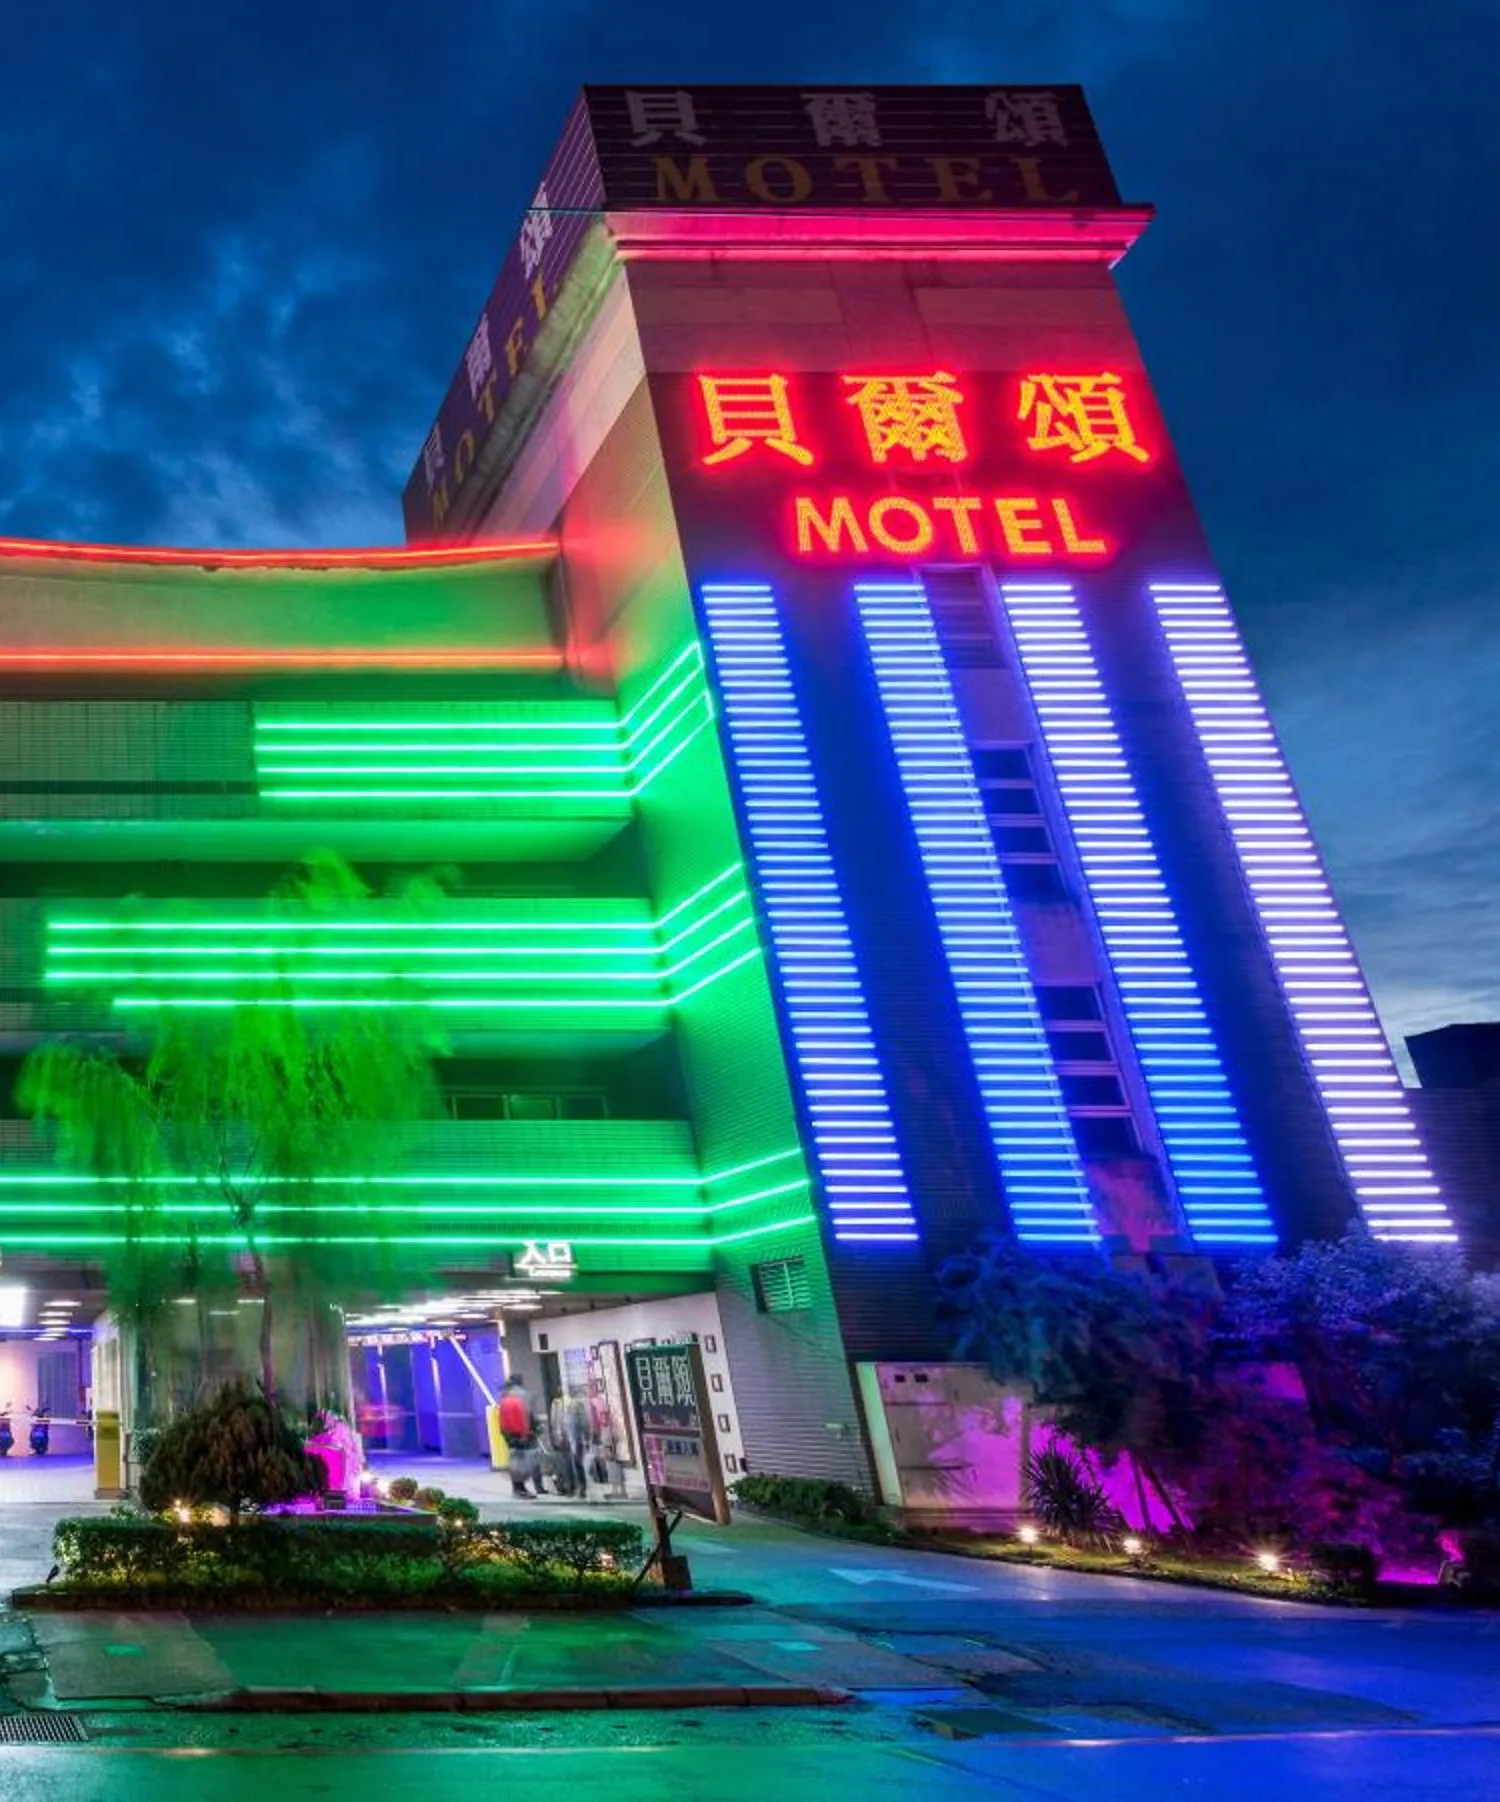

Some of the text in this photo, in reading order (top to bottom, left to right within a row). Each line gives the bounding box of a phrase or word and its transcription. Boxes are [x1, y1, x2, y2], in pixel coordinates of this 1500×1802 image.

[627, 90, 1069, 146] 貝爾頌
[653, 155, 1078, 203] MOTEL
[697, 371, 1150, 465] 貝爾頌
[795, 497, 1106, 554] MOTEL
[521, 1240, 571, 1264] 入口
